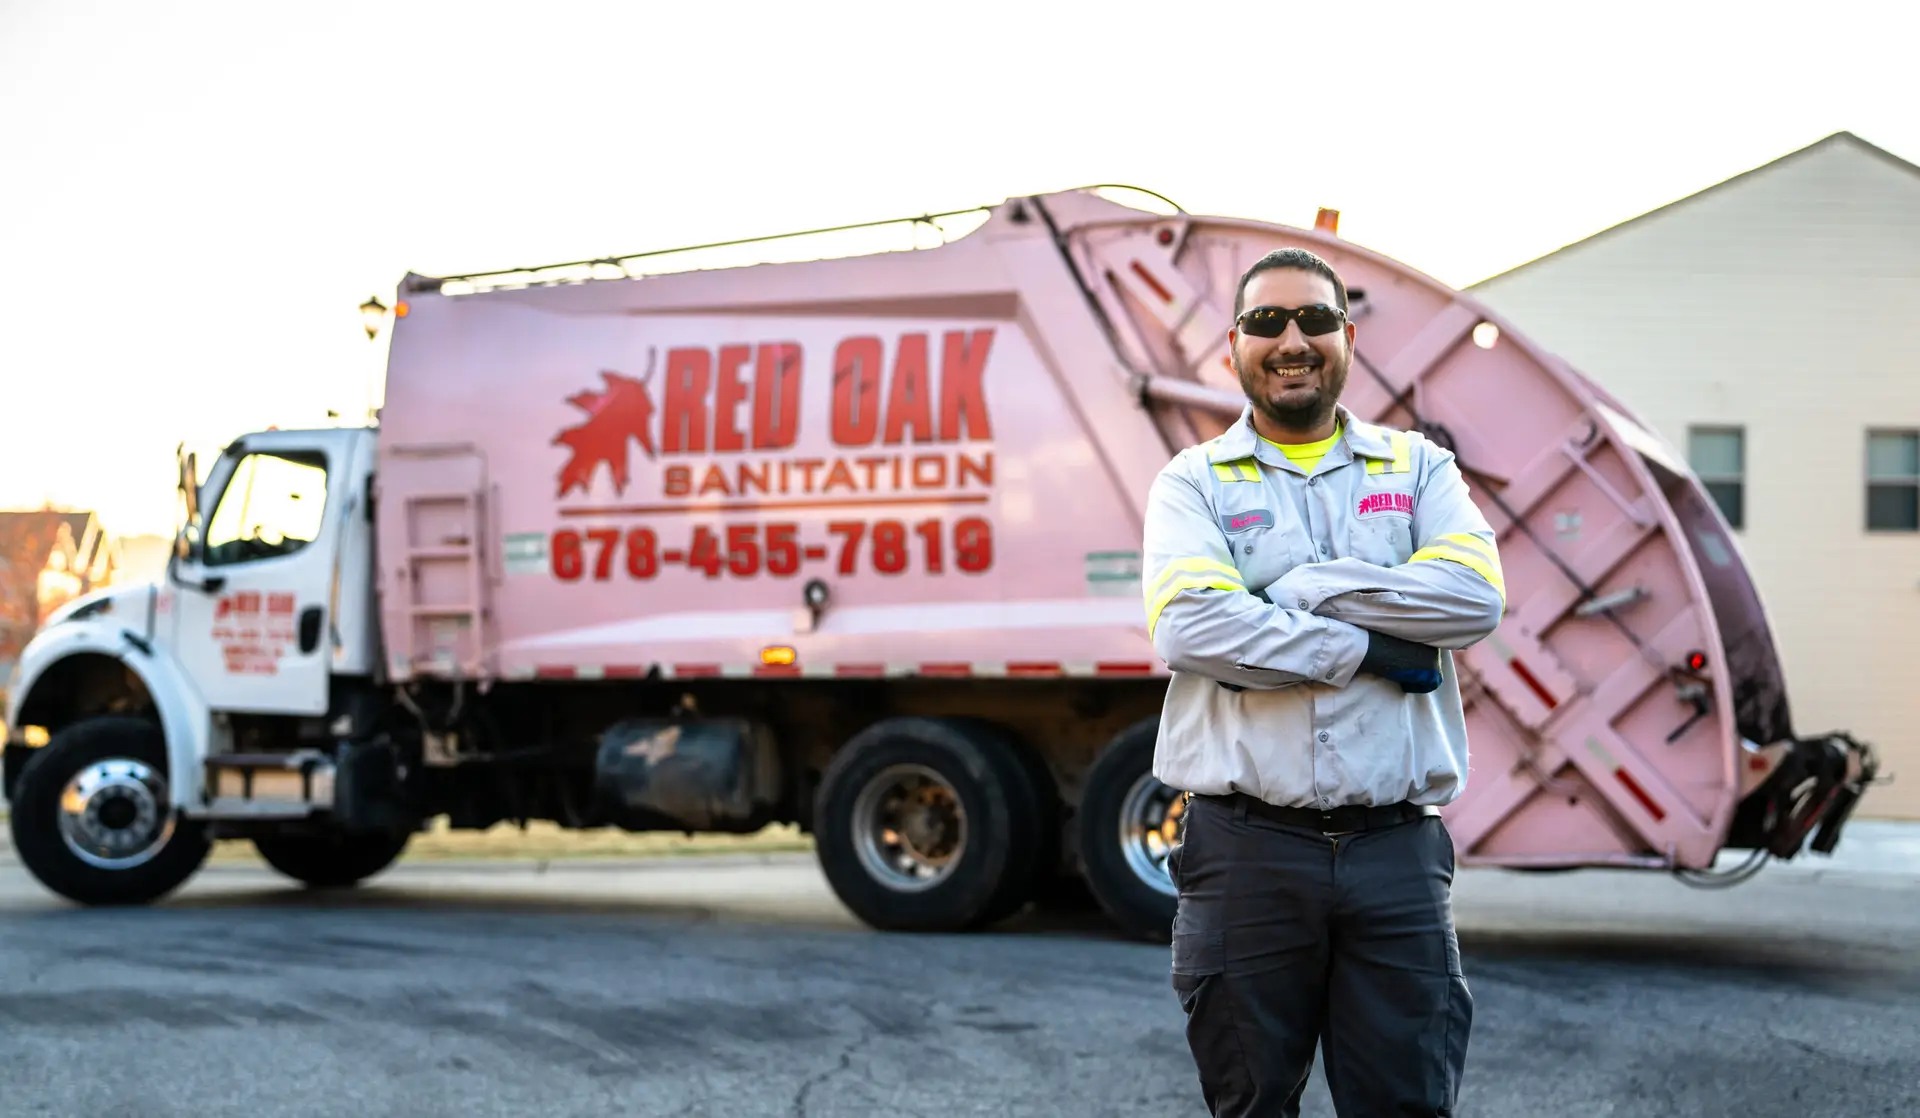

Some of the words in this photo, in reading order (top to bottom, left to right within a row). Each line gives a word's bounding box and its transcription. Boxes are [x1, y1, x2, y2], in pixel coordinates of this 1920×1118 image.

[661, 341, 804, 452] RED
[830, 329, 996, 447] OAK
[663, 452, 994, 498] SANITATION
[1369, 492, 1393, 508] RED
[551, 517, 993, 581] 678-455-7819
